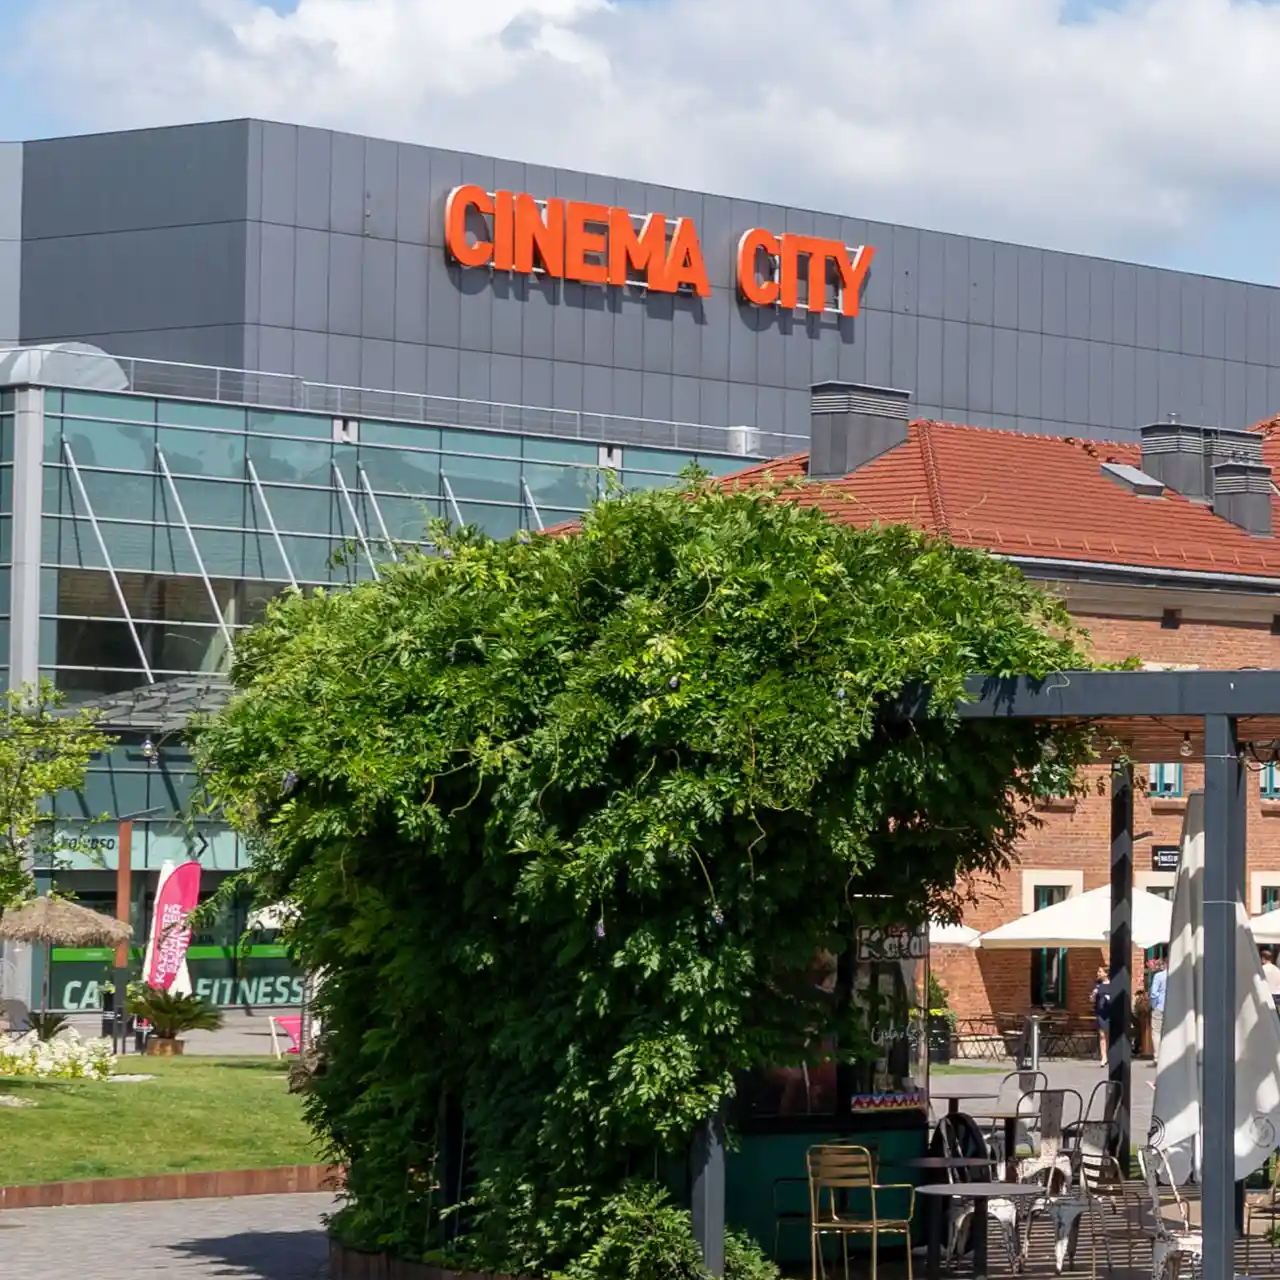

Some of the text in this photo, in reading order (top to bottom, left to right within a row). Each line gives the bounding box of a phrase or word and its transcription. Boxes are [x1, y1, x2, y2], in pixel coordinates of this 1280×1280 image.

[446, 184, 876, 317] CINEMA CITY
[196, 975, 304, 1006] FITNESS
